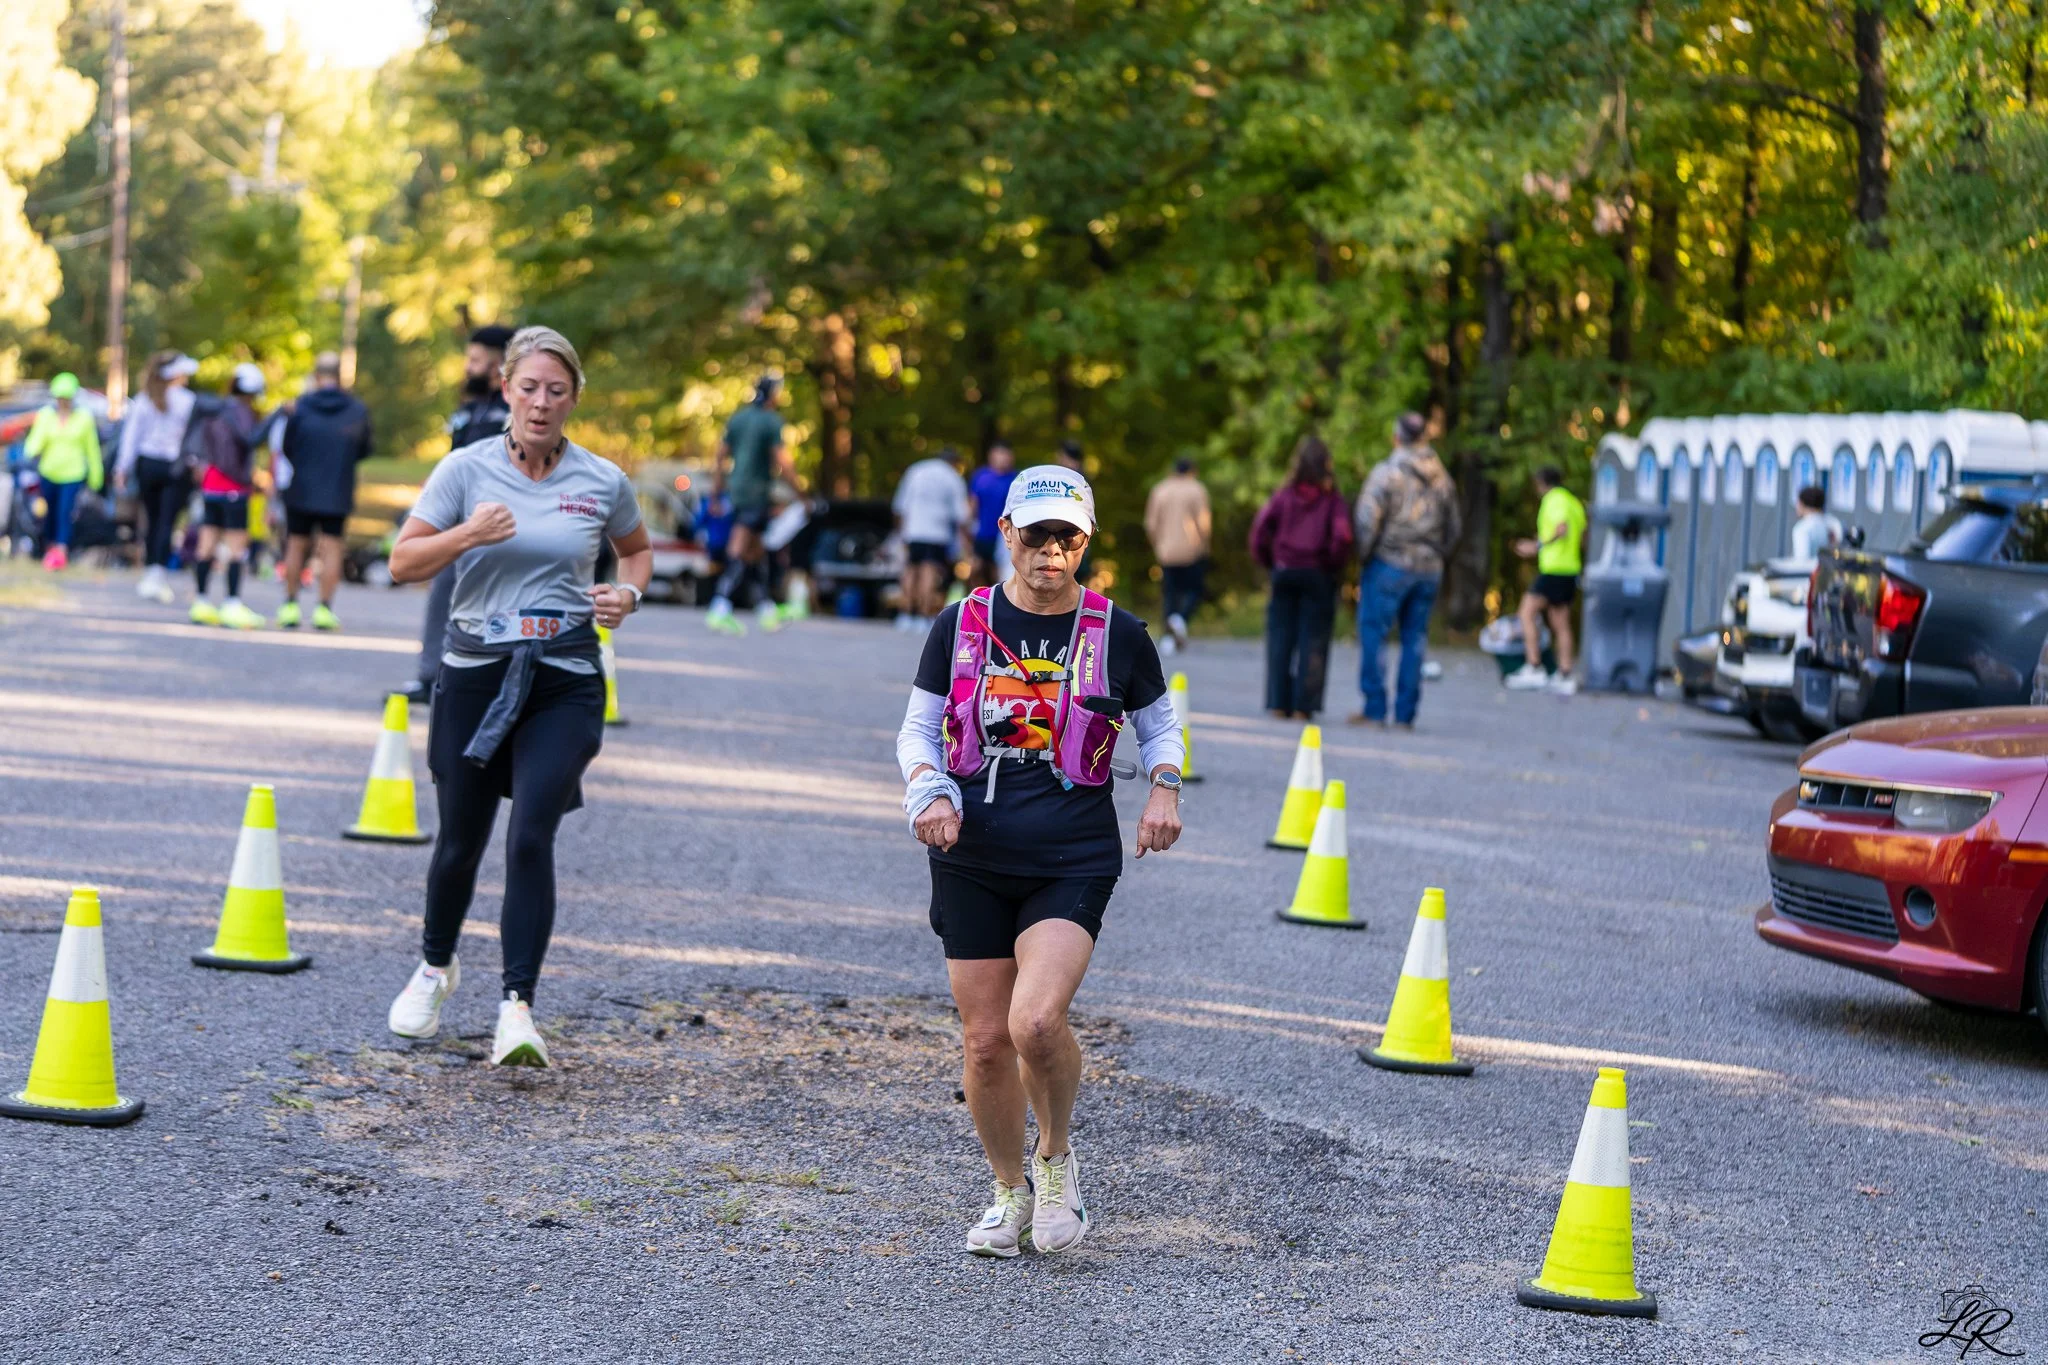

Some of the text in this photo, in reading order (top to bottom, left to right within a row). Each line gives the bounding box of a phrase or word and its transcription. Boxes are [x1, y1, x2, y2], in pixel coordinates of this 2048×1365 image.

[1031, 480, 1060, 489] MAUI
[559, 502, 598, 517] HERO
[521, 617, 560, 639] 859
